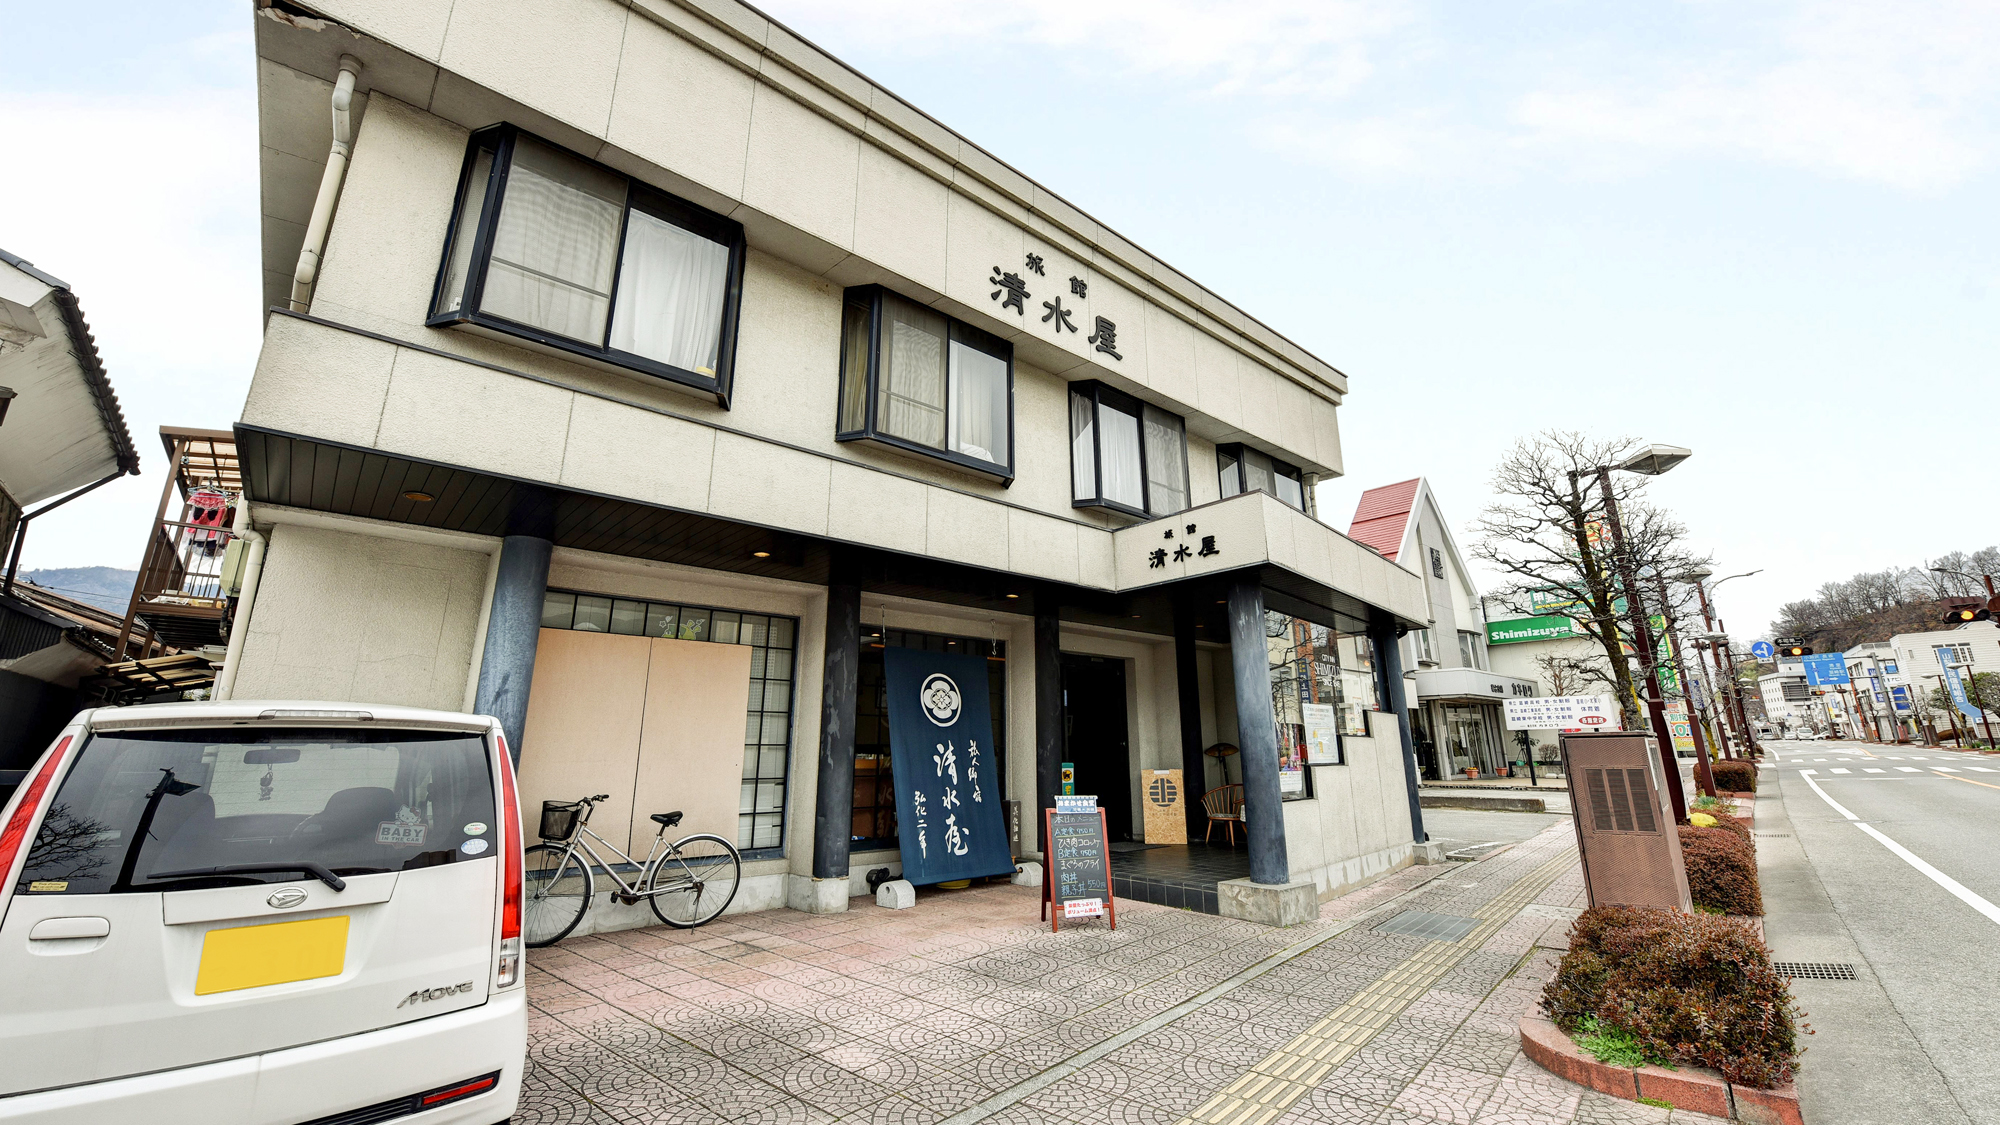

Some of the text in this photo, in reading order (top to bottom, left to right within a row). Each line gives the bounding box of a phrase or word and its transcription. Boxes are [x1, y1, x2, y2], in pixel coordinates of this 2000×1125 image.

[1026, 252, 1087, 298] 旅館
[989, 265, 1123, 361] 清水屋
[1163, 523, 1196, 539] 旅館
[1148, 535, 1220, 569] 清水屋
[1491, 626, 1570, 641] Shimizuya
[1941, 653, 1965, 703] 山梨民信用組合
[932, 740, 970, 856] 清水屋
[1054, 814, 1100, 824] 本日のメニュー
[381, 827, 423, 838] BABY
[1054, 826, 1076, 836] A定食
[1057, 837, 1102, 848] ひき肉コロッケ
[1057, 847, 1079, 859] B定食
[1060, 858, 1100, 870] まぐろのフライ
[1061, 881, 1087, 896] 親子丼
[396, 980, 474, 1009] MOVE
